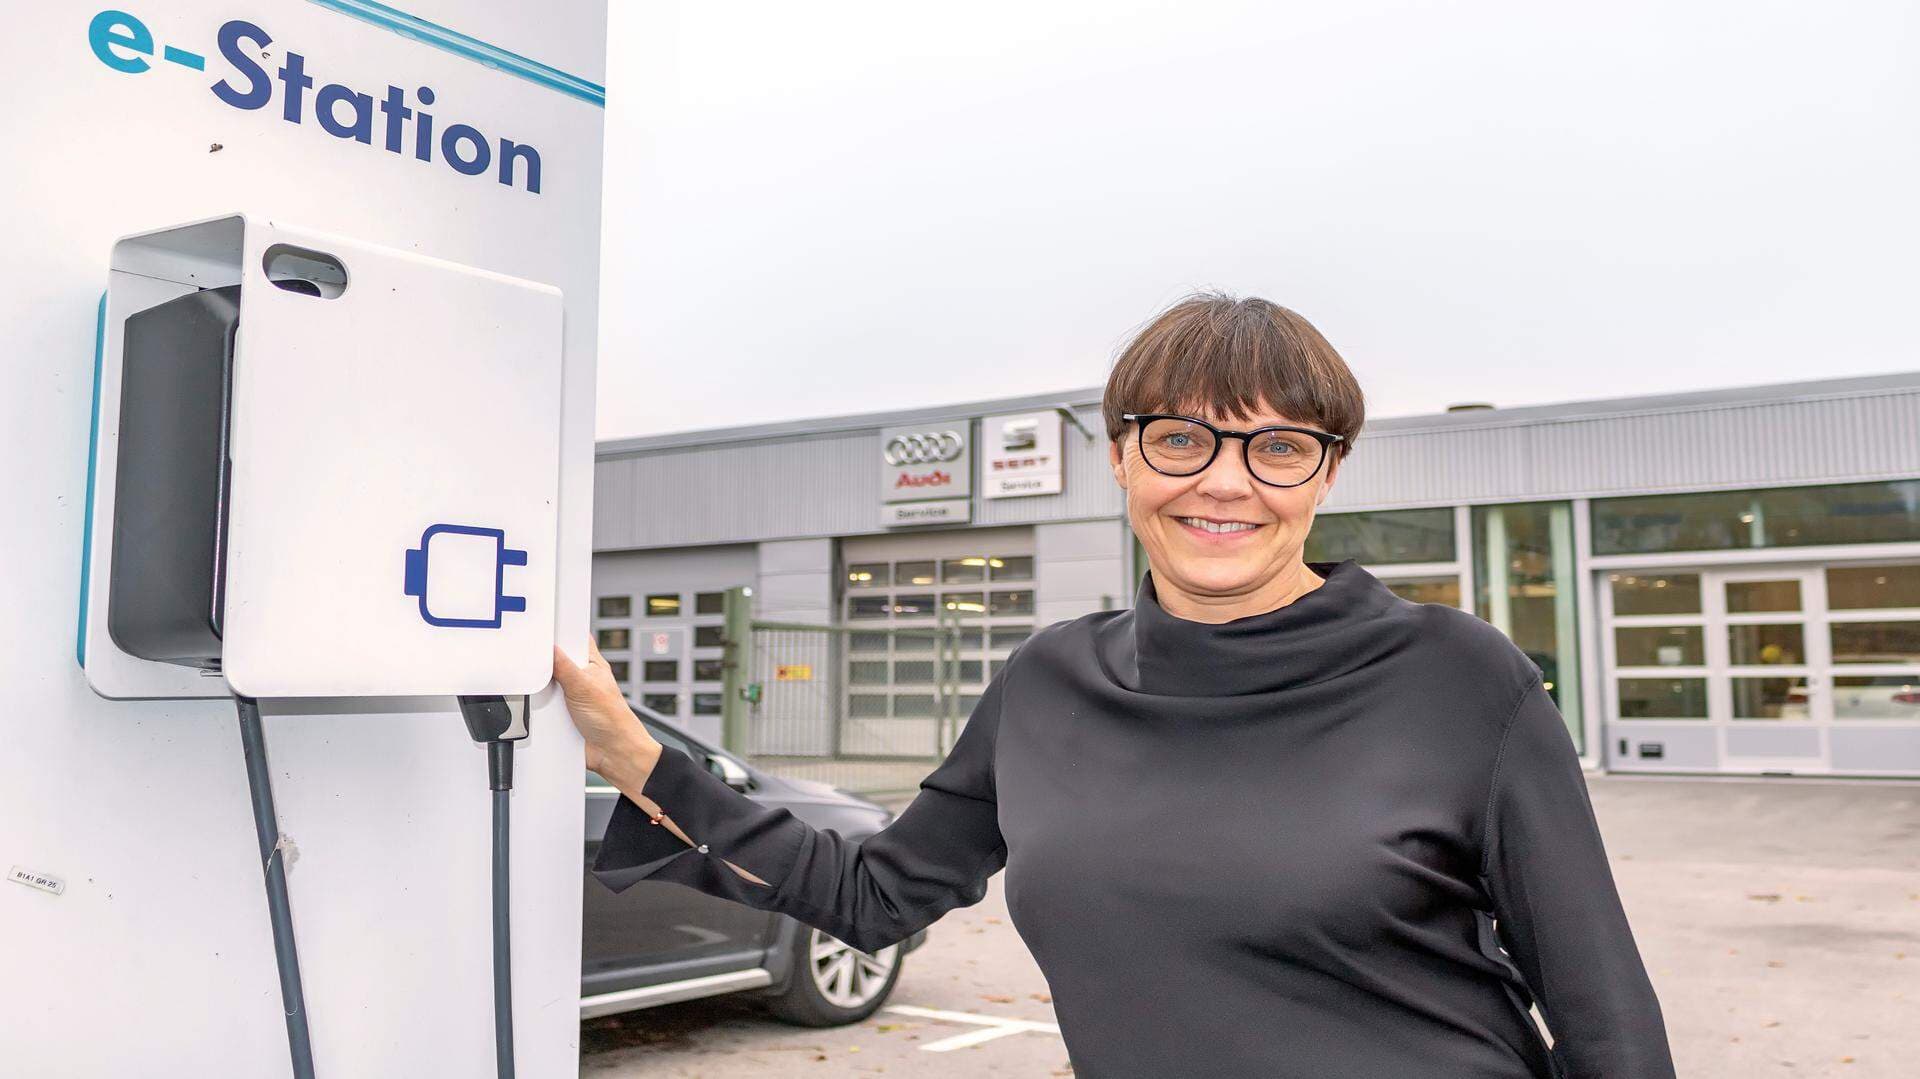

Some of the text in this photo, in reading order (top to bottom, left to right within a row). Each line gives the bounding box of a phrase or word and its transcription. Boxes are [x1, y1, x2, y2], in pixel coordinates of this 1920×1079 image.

[88, 9, 542, 195] e-Station
[992, 455, 1051, 471] SEAT
[895, 470, 951, 489] Audi
[1001, 480, 1043, 492] Service
[897, 507, 948, 519] Service
